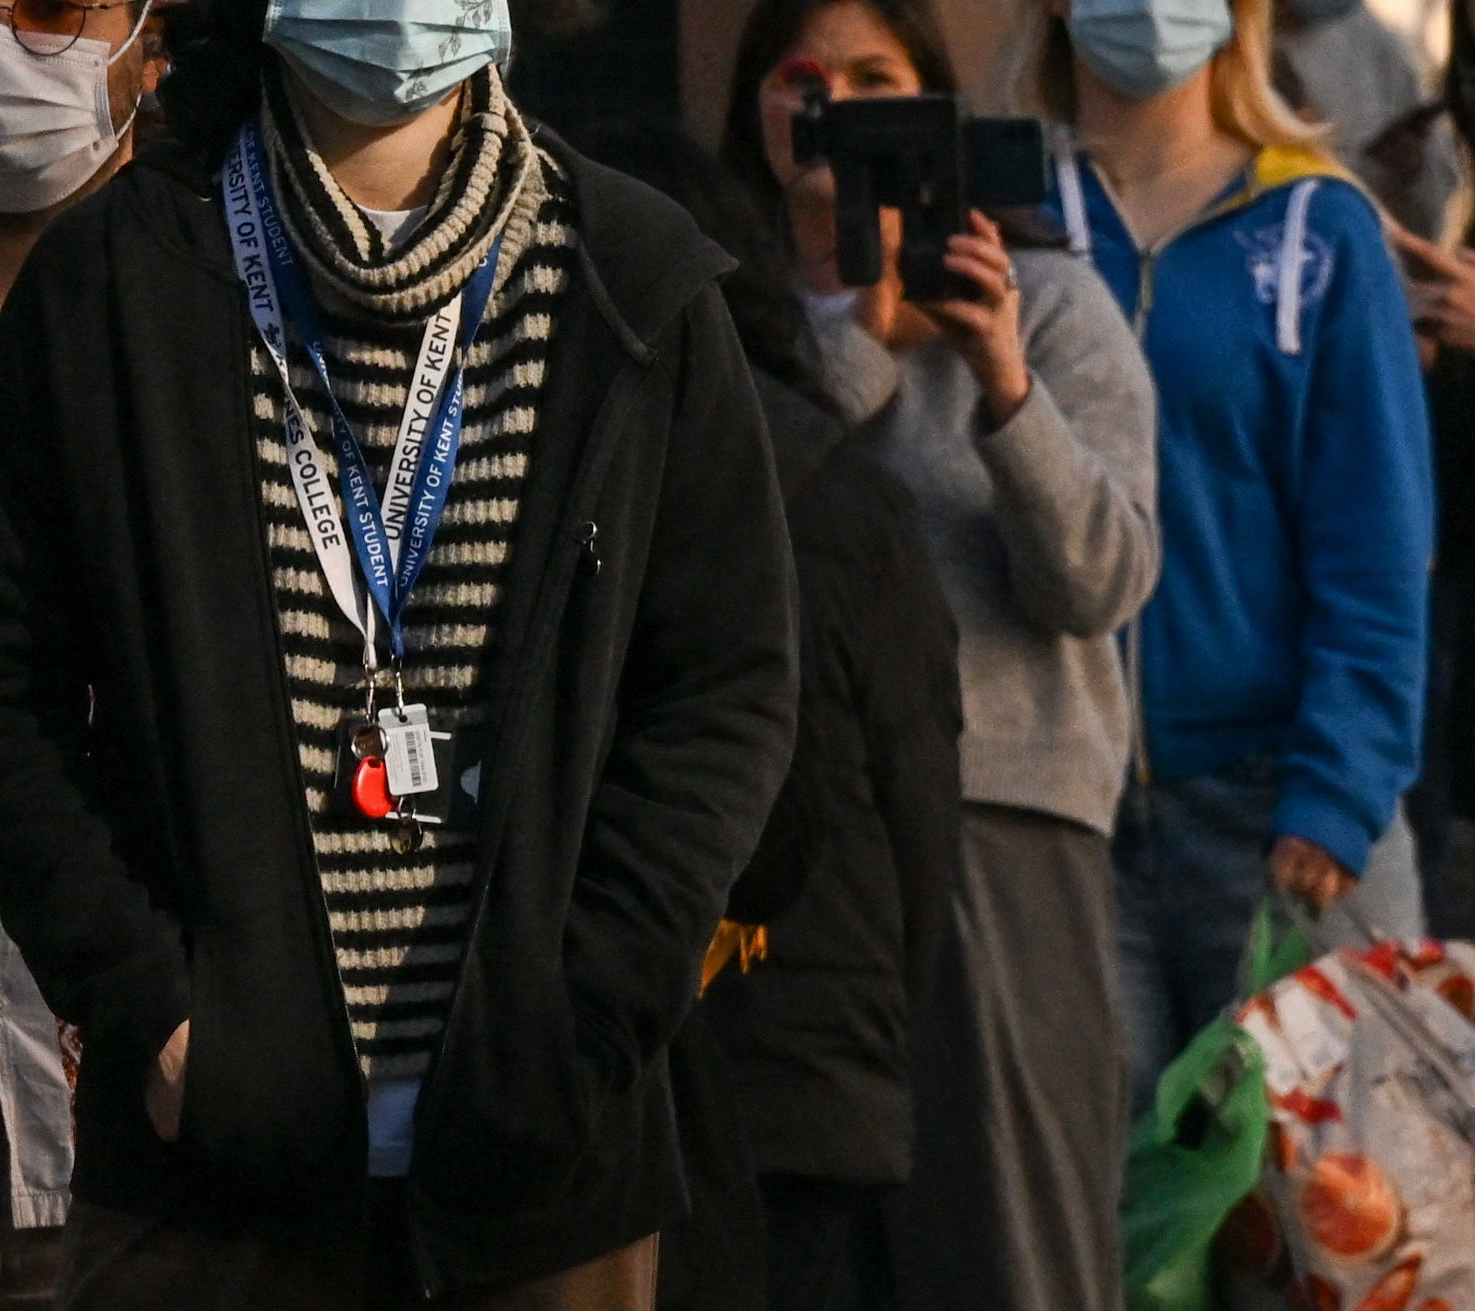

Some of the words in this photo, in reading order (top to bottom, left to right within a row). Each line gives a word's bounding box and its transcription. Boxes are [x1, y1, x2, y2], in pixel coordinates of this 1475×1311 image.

[227, 145, 253, 215] ERSITY
[247, 152, 265, 191] KENT
[258, 195, 295, 266] STUDENT
[236, 221, 259, 249] OF
[242, 254, 274, 313] KENT
[424, 311, 452, 373] KENT
[415, 374, 437, 406] OF
[342, 439, 356, 462] OF
[433, 418, 455, 463] KENT
[295, 449, 341, 550] COLLEGE
[347, 464, 370, 509] KENT
[384, 409, 431, 542] UNIVERSITY
[425, 464, 442, 488] OF
[358, 511, 392, 588] STUDENT
[398, 491, 434, 588] UNIVERSITY
